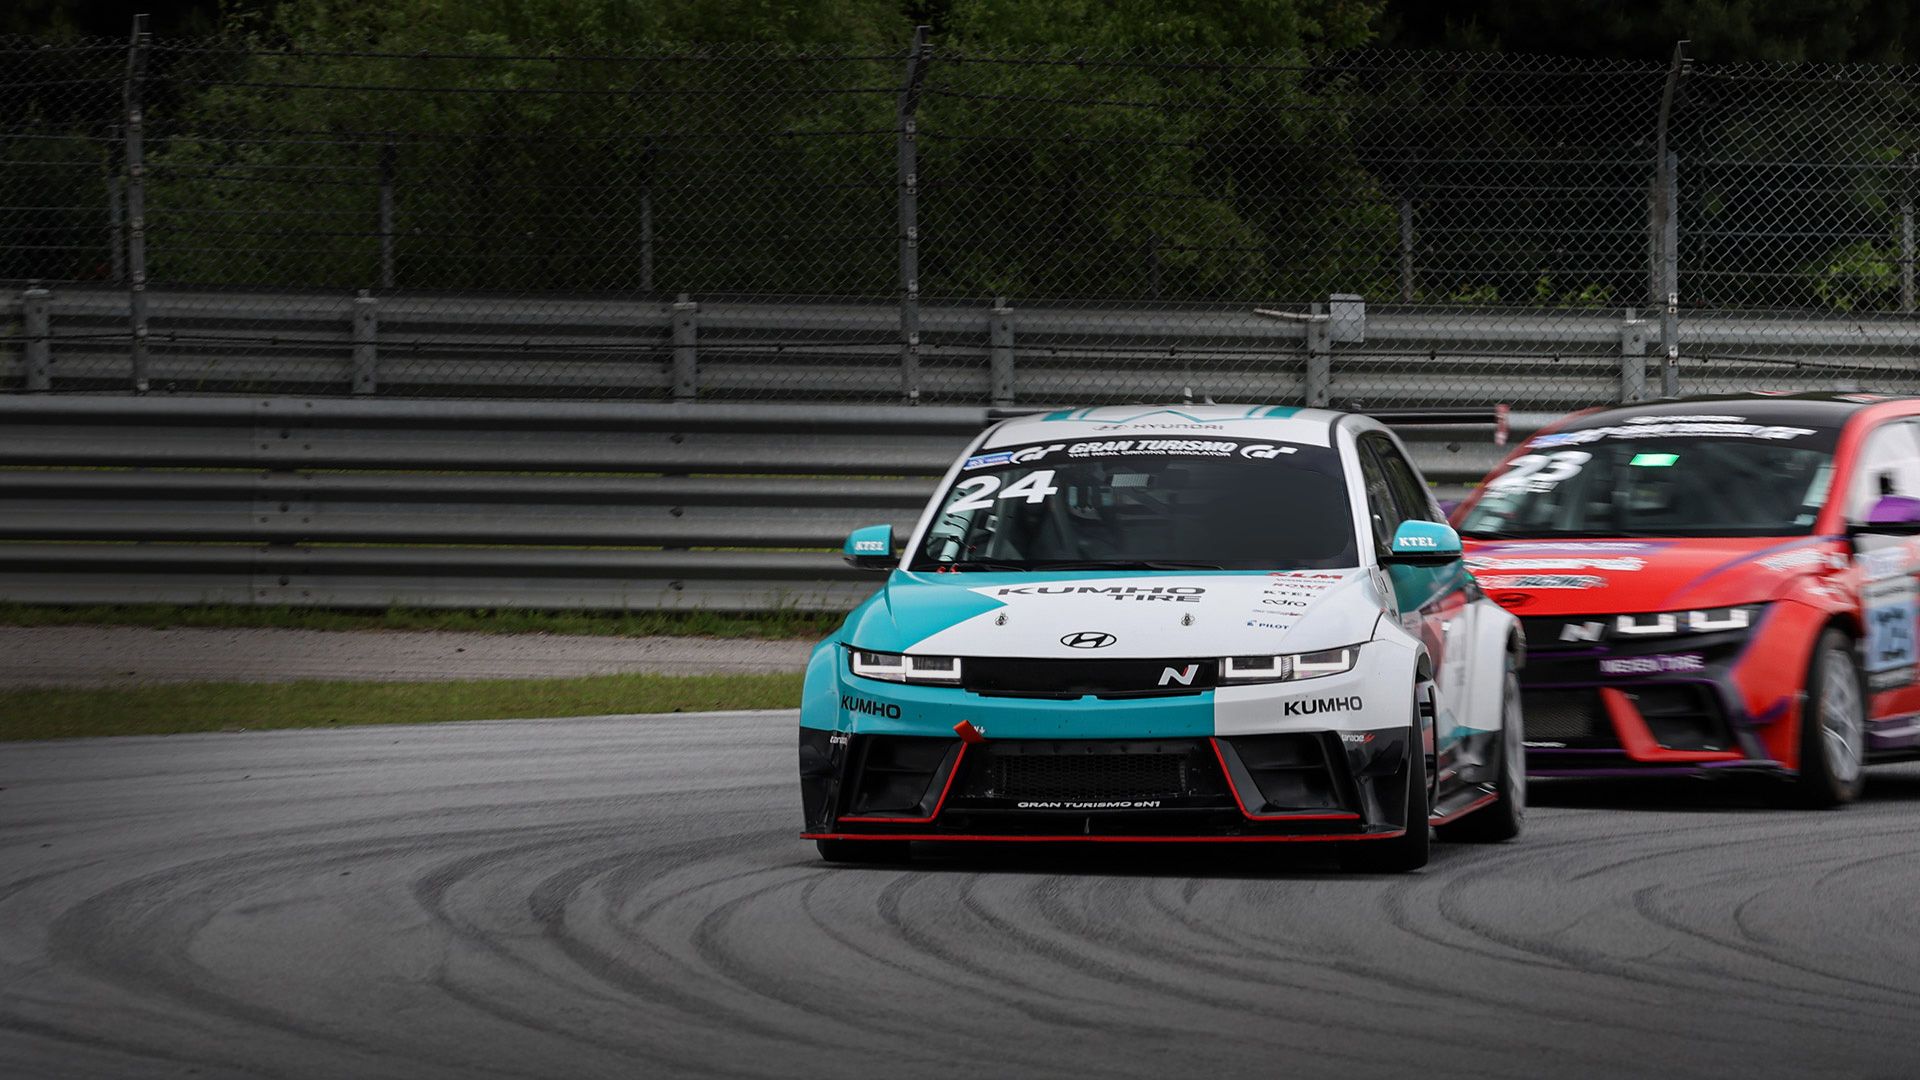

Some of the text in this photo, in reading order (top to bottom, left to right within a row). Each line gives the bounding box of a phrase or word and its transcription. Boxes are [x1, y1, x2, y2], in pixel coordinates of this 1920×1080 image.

[1068, 439, 1238, 454] GRAN TURISMO
[945, 469, 1059, 514] 24
[1398, 536, 1438, 547] KTEL
[998, 586, 1206, 596] KUMHO
[1107, 594, 1202, 603] TIRE
[1258, 622, 1290, 630] PILOT
[840, 694, 902, 720] KUMHO
[1284, 695, 1363, 716] KUMHO
[1133, 800, 1161, 808] eN1
